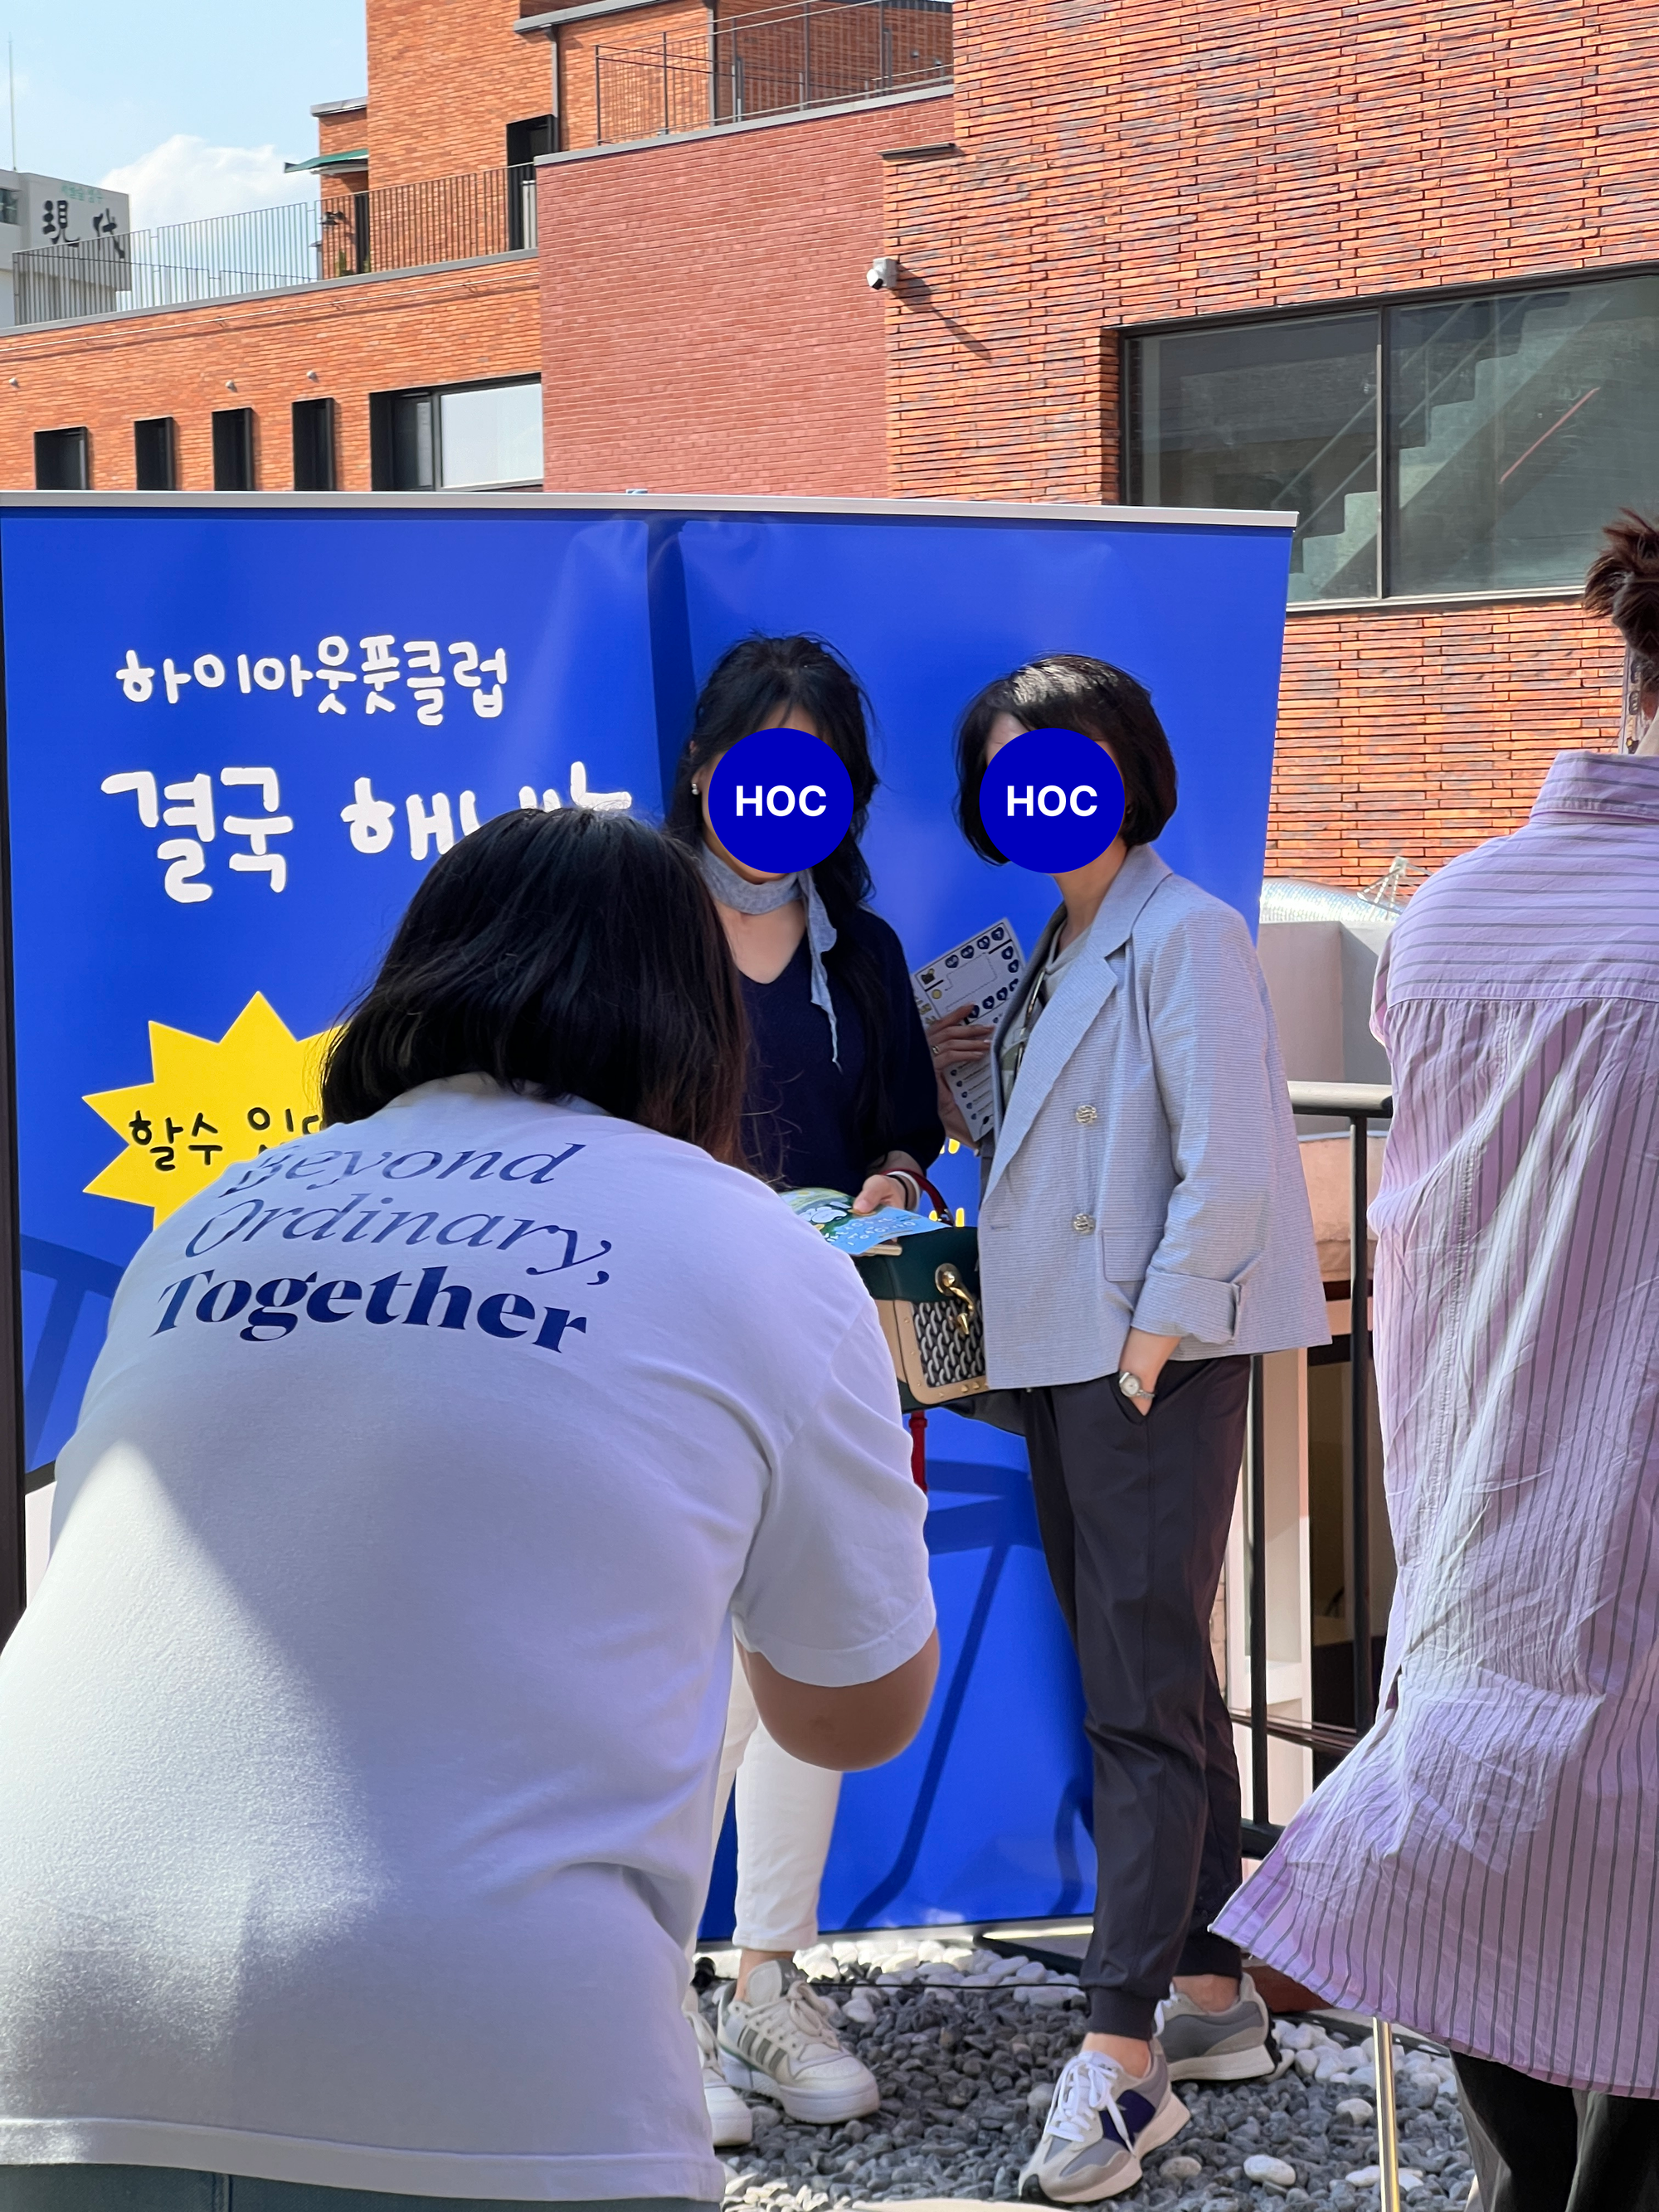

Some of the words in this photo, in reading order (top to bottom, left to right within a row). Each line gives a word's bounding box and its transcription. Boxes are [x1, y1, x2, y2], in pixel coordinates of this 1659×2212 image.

[115, 634, 508, 726] 하이아웃풋클럽
[100, 766, 294, 903] 결국
[129, 1110, 223, 1171] 할수
[218, 1142, 585, 1198] Beyond
[185, 1191, 612, 1286] Ordinary,
[150, 1266, 586, 1354] Together
